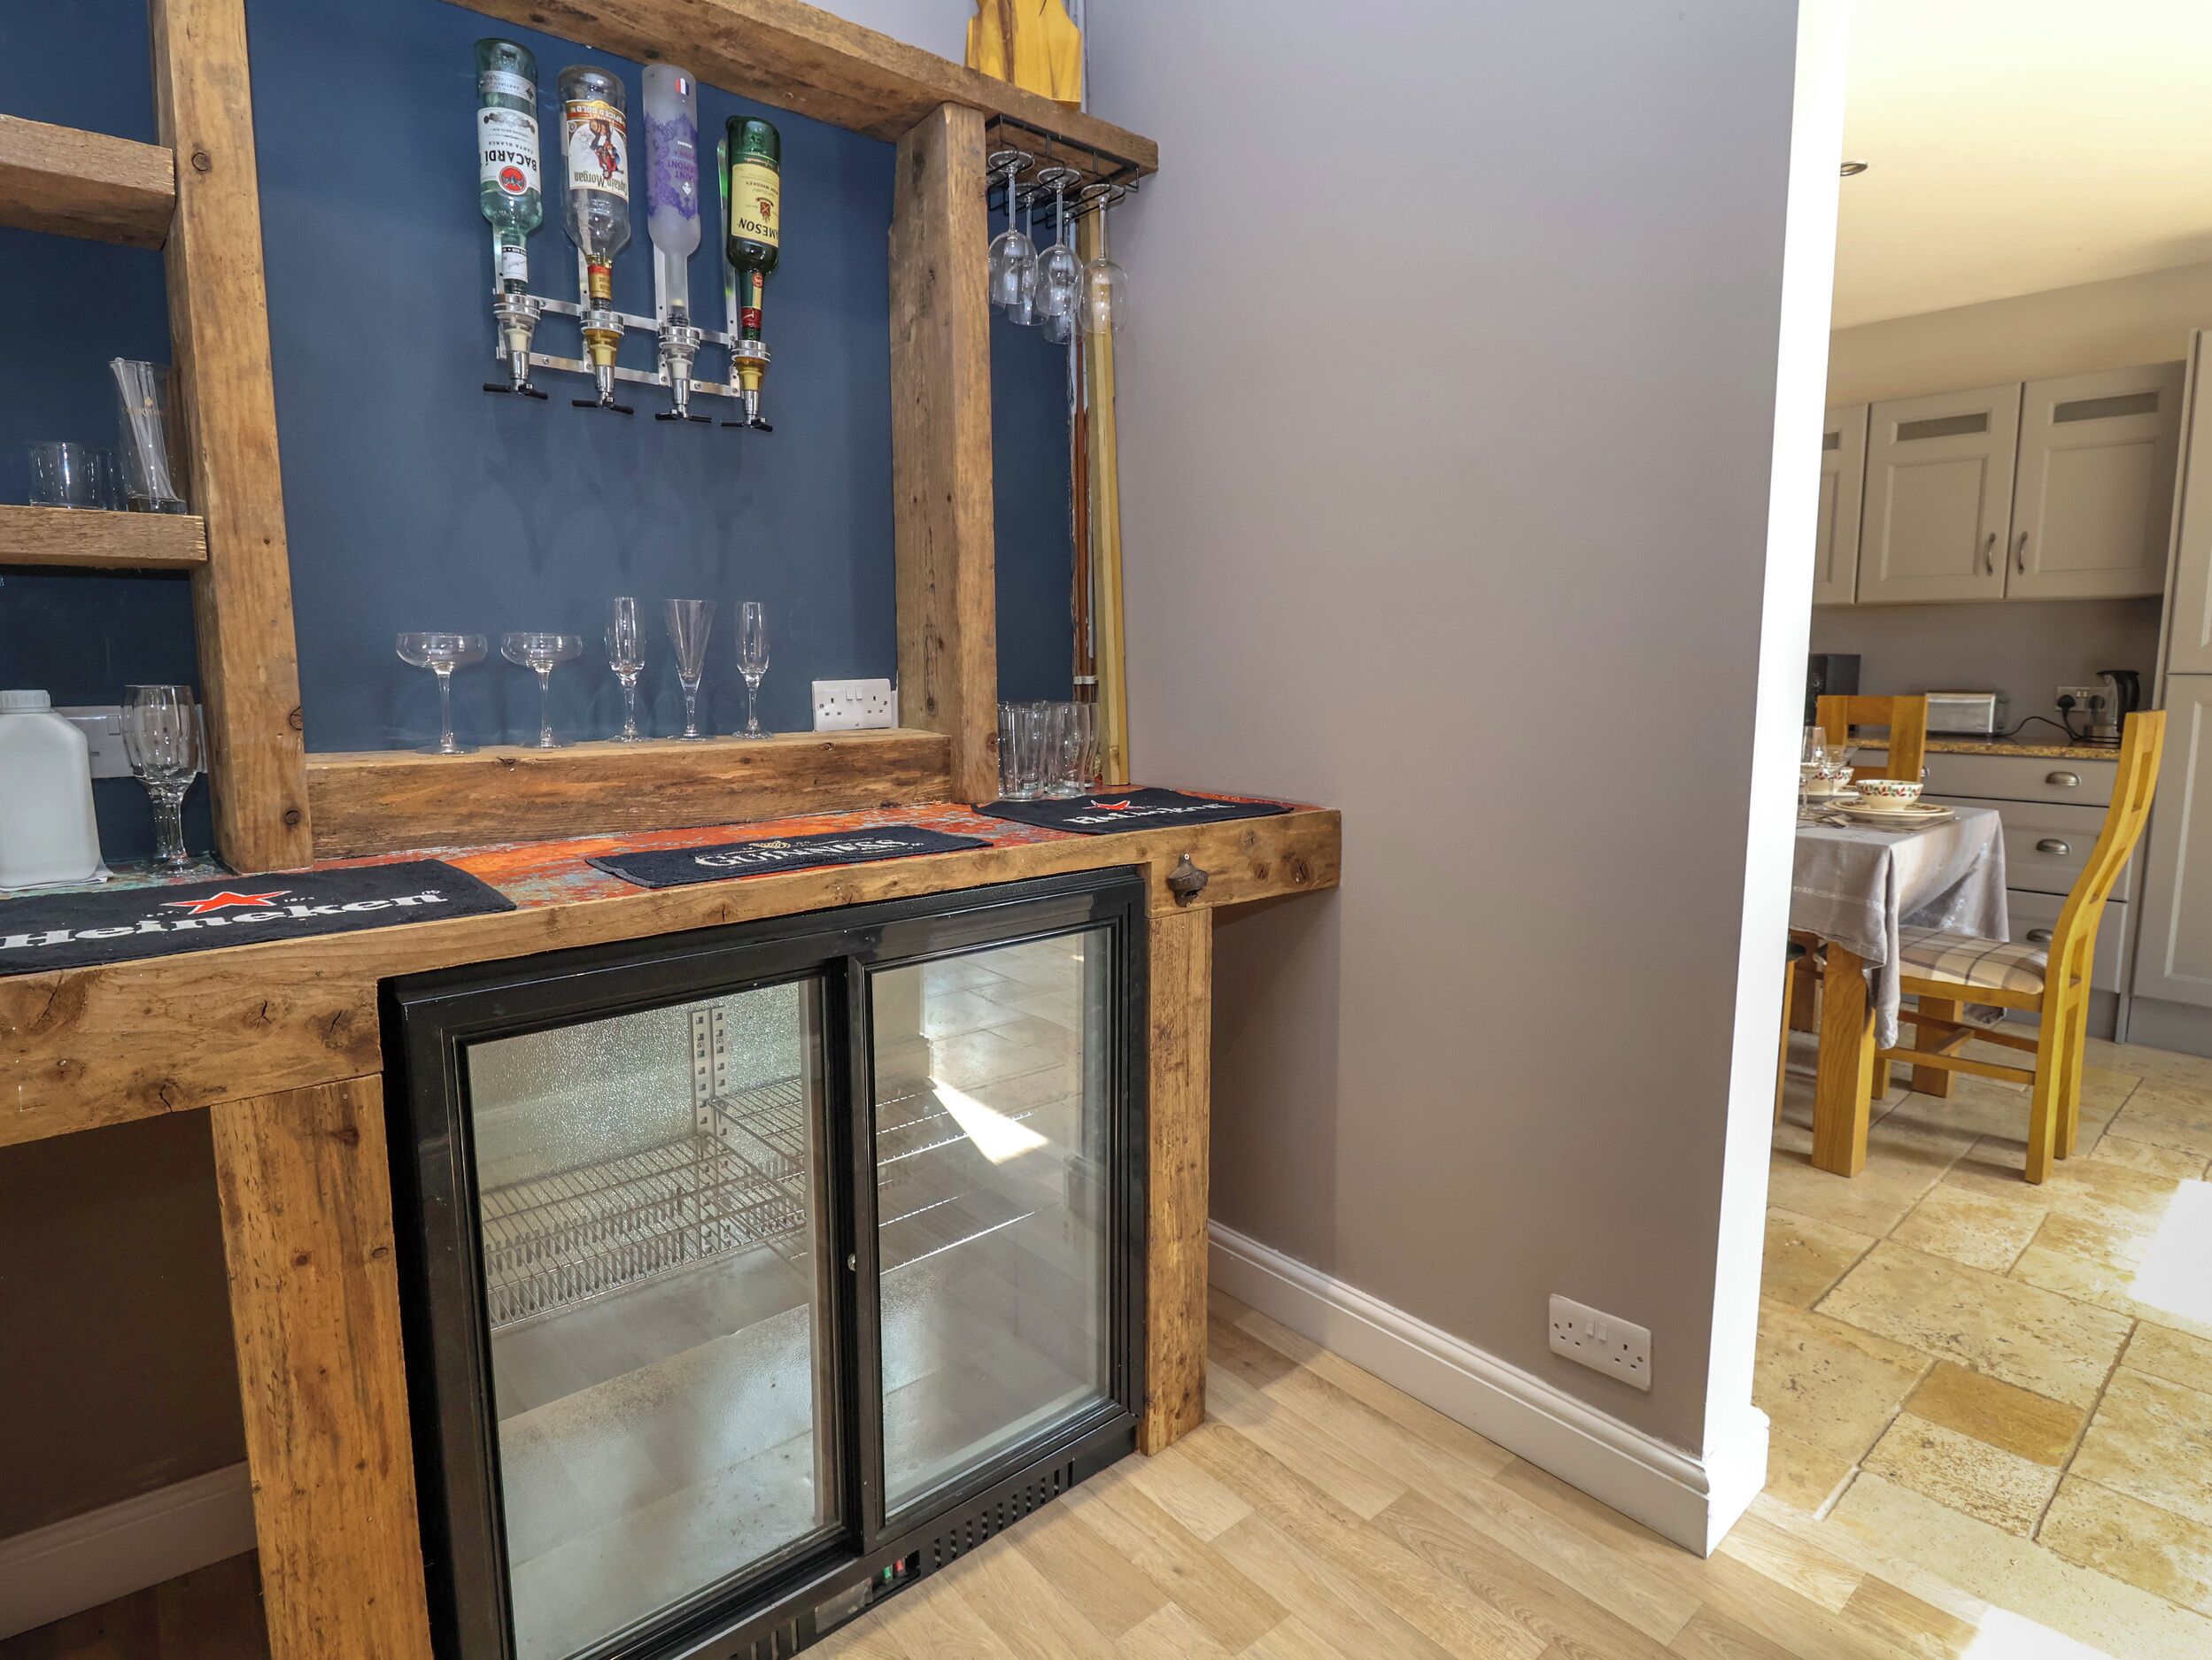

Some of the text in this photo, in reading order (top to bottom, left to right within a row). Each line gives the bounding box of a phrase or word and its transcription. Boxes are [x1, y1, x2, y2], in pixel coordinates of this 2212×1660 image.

[484, 151, 538, 172] BACARDÍ
[573, 170, 605, 188] Morgan
[694, 839, 909, 867] GUINNESS
[0, 894, 448, 948] Heineken
